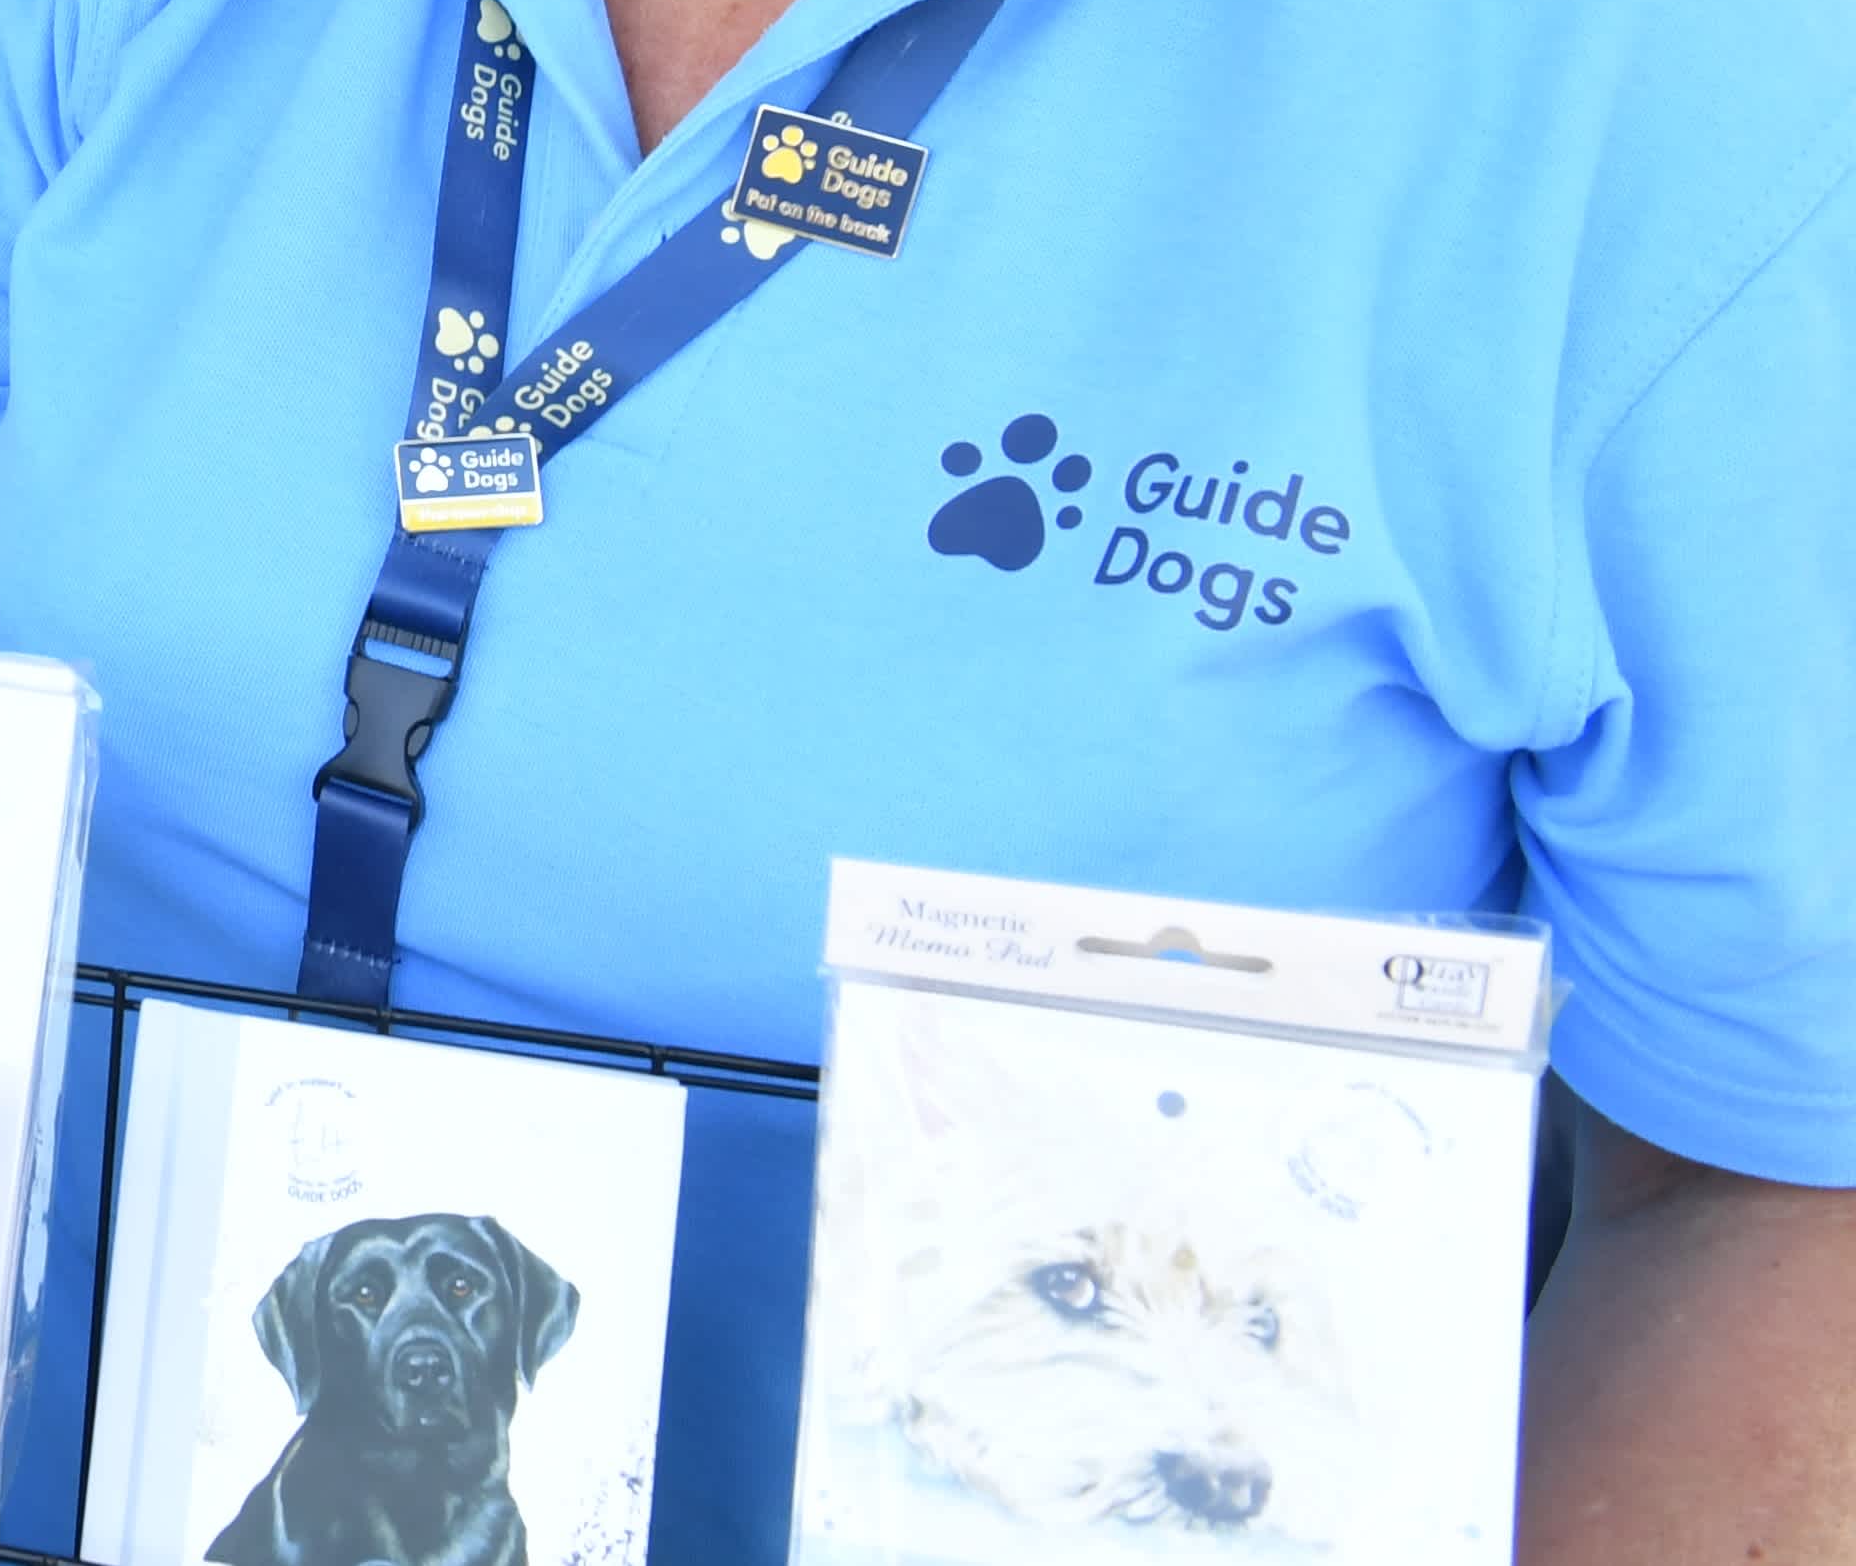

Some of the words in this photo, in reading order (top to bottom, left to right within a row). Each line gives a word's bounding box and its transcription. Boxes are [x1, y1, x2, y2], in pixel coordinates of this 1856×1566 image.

[461, 62, 497, 142] Dogs
[493, 73, 523, 162] Guide
[821, 167, 892, 210] Dogs
[828, 145, 909, 187] Guide
[746, 188, 777, 211] Pat
[779, 200, 804, 220] on
[806, 205, 838, 229] the
[839, 214, 892, 244] back
[514, 339, 595, 410] Guide
[540, 367, 613, 429] Dogs
[417, 377, 458, 442] Dog
[460, 447, 524, 468] Guide
[463, 470, 518, 492] Dogs
[1124, 452, 1351, 555] Guide
[1093, 525, 1300, 632] Dogs
[867, 924, 972, 957] Memo
[899, 897, 1033, 934] Magnetic
